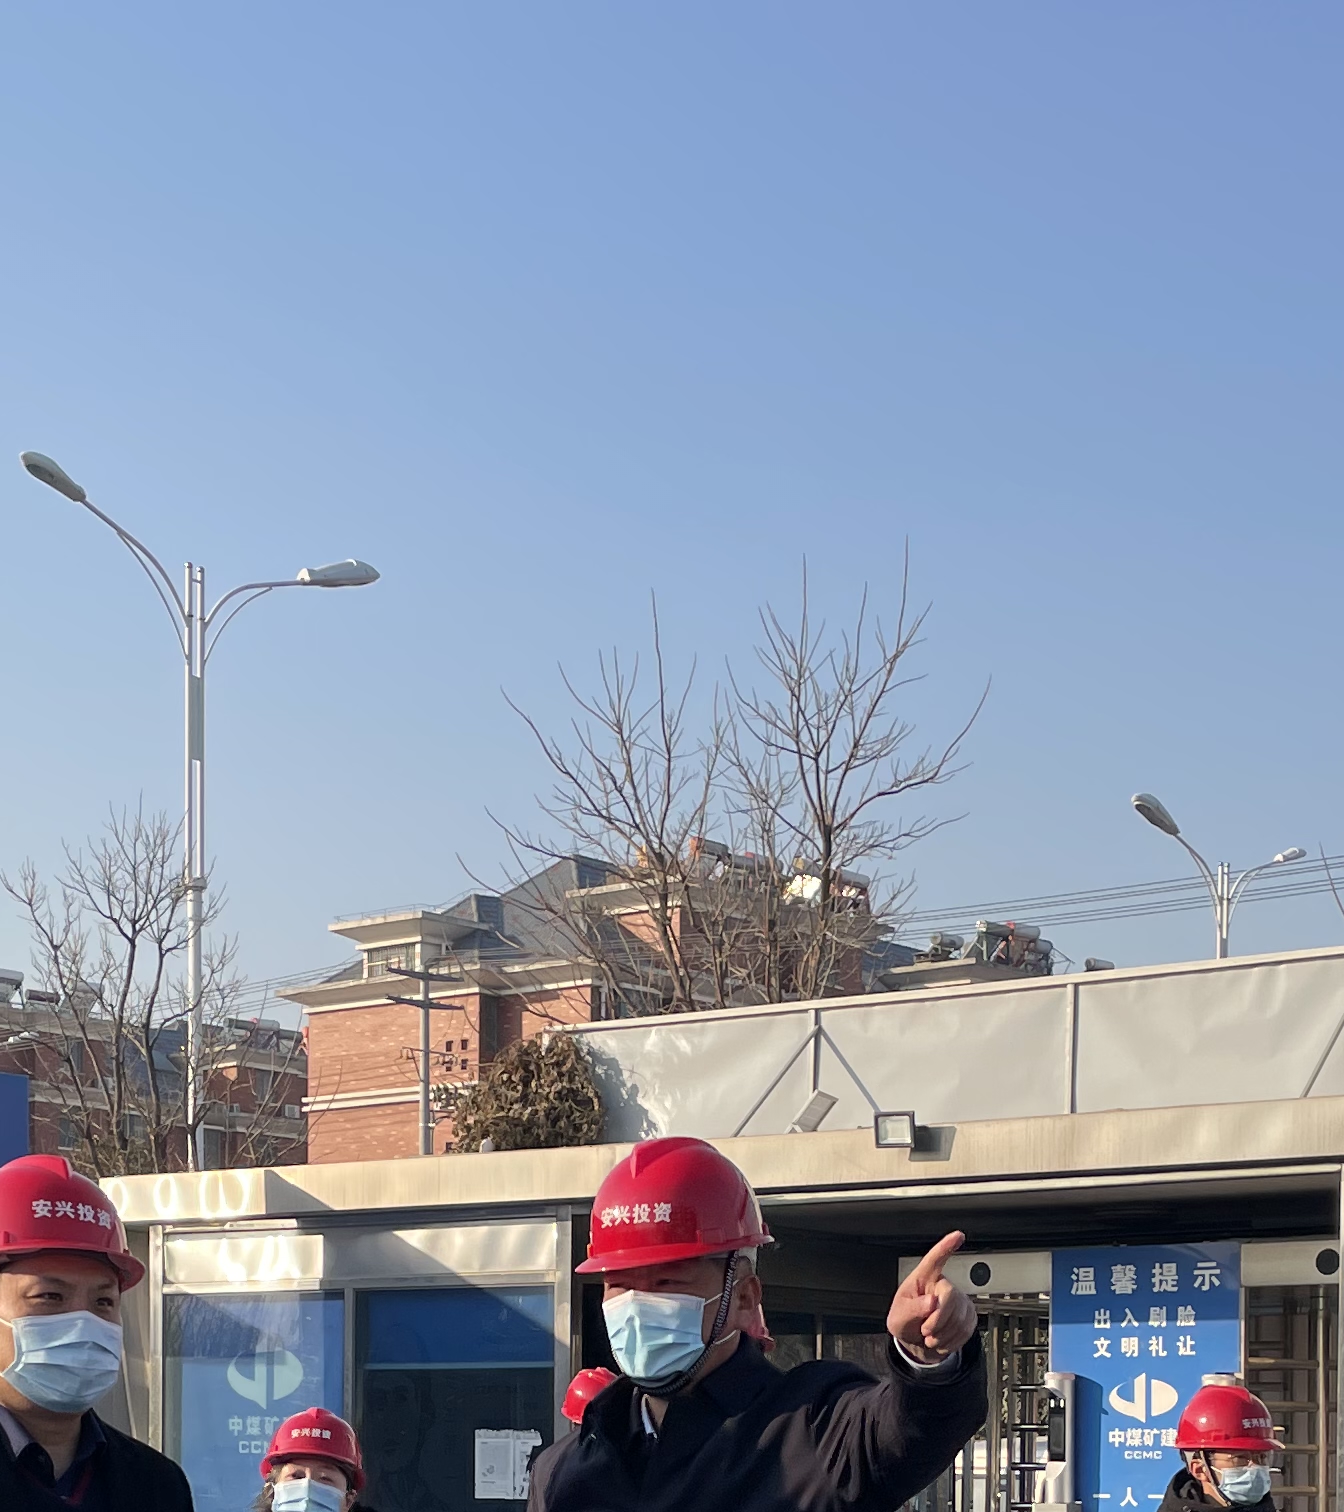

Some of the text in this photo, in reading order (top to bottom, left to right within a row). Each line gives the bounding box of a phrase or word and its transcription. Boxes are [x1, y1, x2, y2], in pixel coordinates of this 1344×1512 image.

[32, 1199, 111, 1230] 安兴投资
[601, 1202, 672, 1228] 安兴投资
[1071, 1262, 1220, 1295] 温馨提示
[1093, 1306, 1196, 1329] 出入刷脸
[1093, 1336, 1196, 1358] 文明礼让
[228, 1416, 288, 1436] 中煤矿
[1109, 1428, 1177, 1447] 中煤矿建
[1125, 1451, 1162, 1459] CCMC
